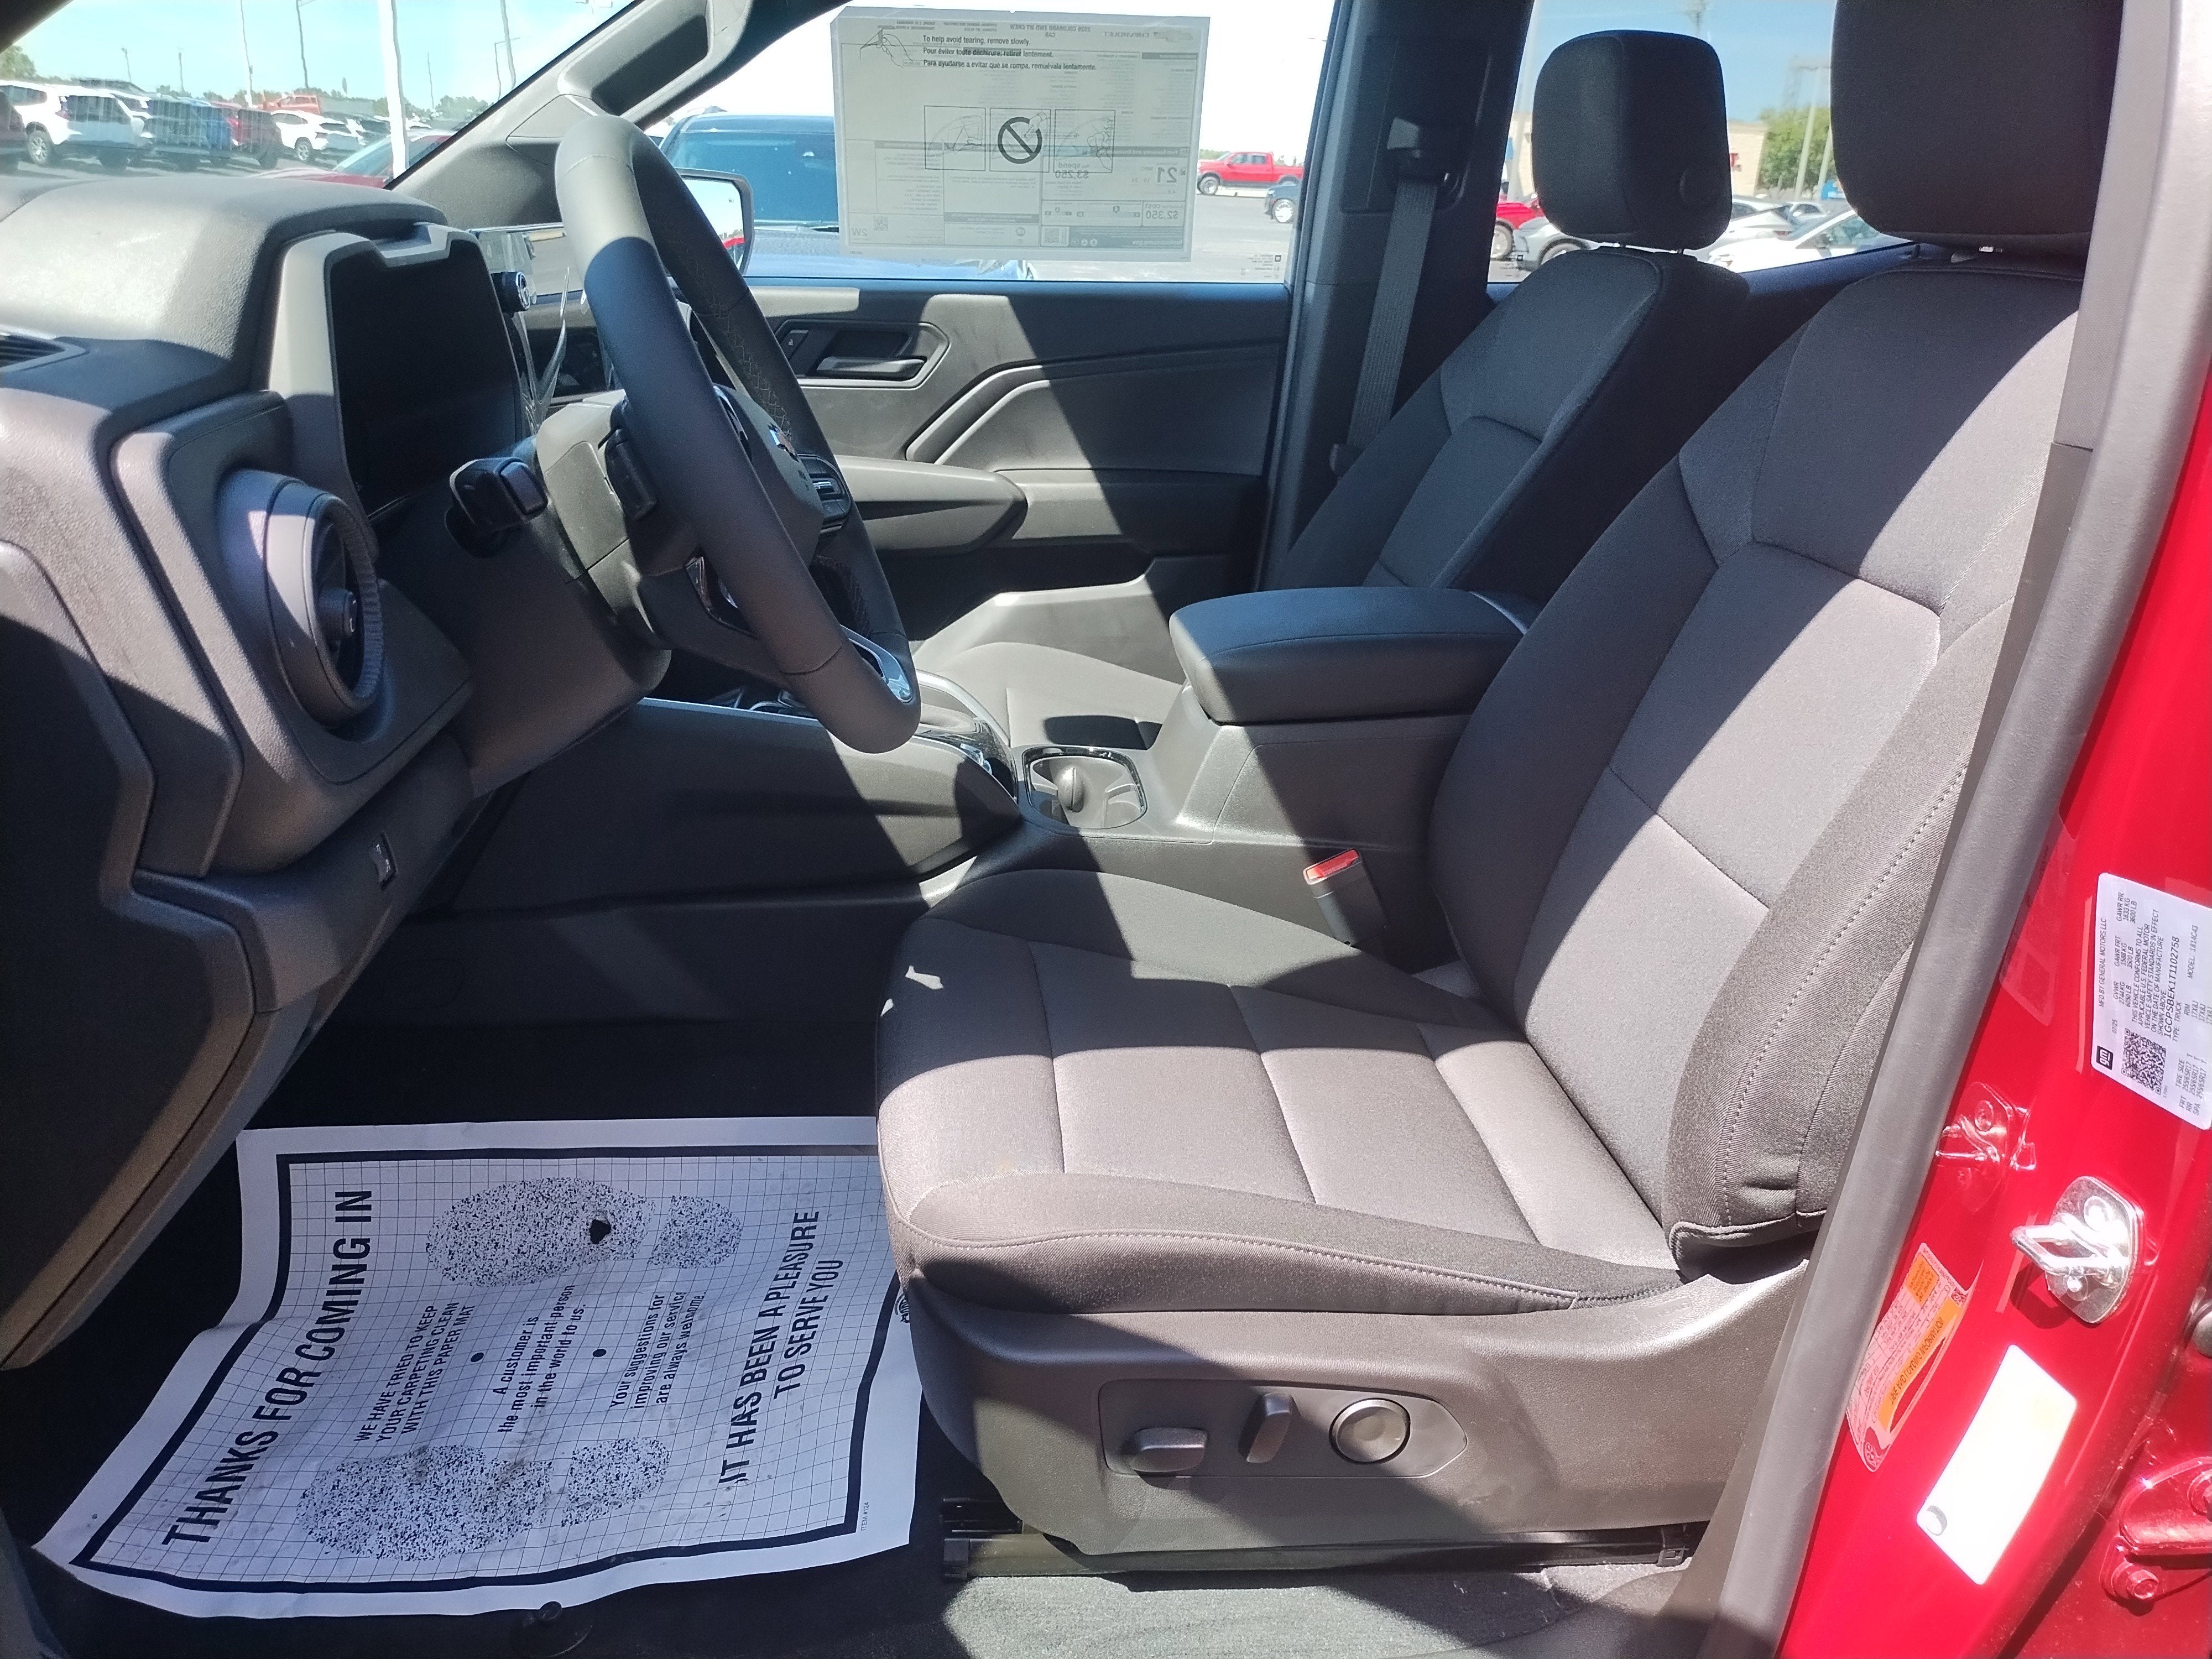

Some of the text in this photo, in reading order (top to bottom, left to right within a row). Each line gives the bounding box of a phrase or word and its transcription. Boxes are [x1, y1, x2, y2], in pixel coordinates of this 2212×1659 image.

[2118, 893, 2124, 901] RR
[2151, 1023, 2157, 1032] ON
[2155, 936, 2163, 982] MANUFACTURE
[2164, 936, 2179, 1038] 1GCPSBEK1T1102758
[2187, 1102, 2192, 1112] RR
[162, 1191, 372, 1545] THANKS FOR COMING IN
[354, 1306, 438, 1441] WE HAVE TRIED TO KEEP
[376, 1302, 459, 1442] YOUR CARPETING CLEAN
[401, 1306, 475, 1434] WITH THIS PAPER MAT
[498, 1285, 575, 1432] the most important person
[500, 1330, 533, 1382] customer
[523, 1317, 539, 1326] is
[530, 1305, 586, 1408] in the world to us.
[609, 1295, 664, 1408] Your suggestions for
[630, 1352, 666, 1409] improving
[656, 1332, 671, 1348] our
[656, 1292, 706, 1404] are always welcome.
[718, 1211, 820, 1484] IT HAS BEEN A PLEASURE
[774, 1260, 844, 1399] TO SERVE YOU
